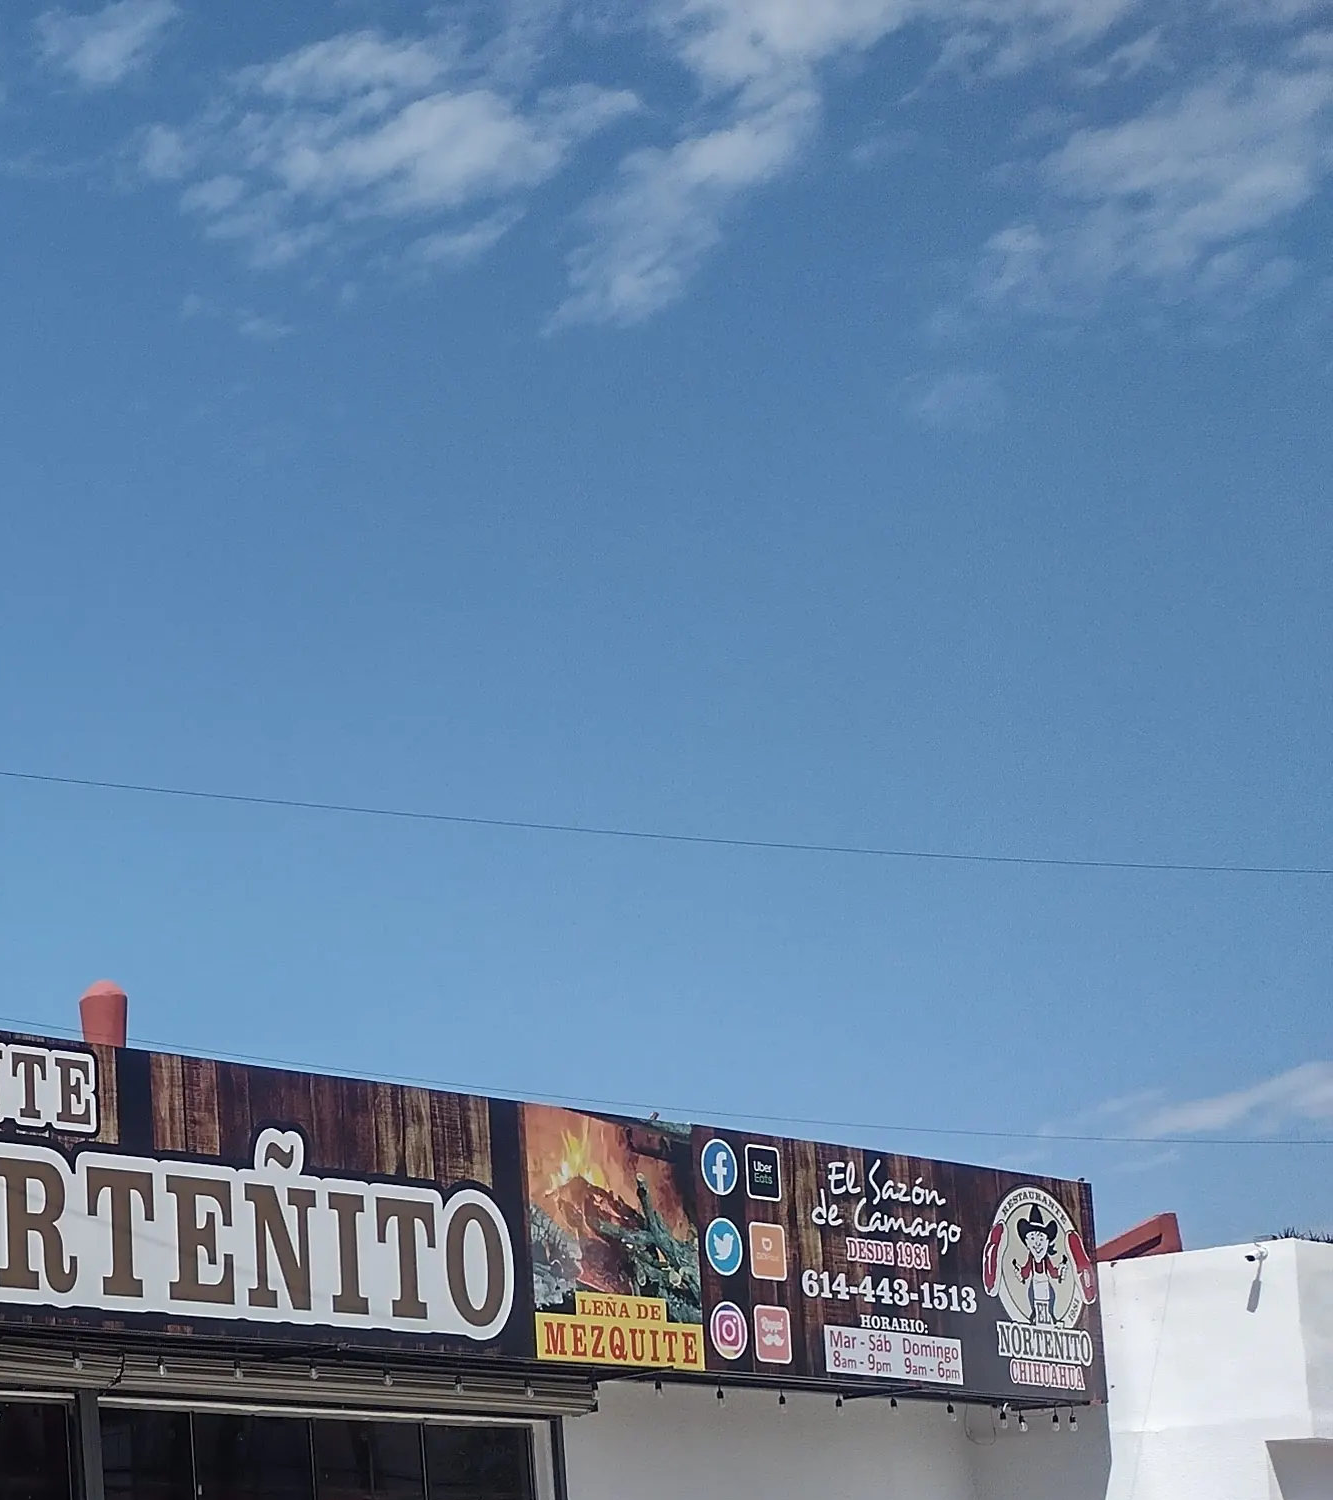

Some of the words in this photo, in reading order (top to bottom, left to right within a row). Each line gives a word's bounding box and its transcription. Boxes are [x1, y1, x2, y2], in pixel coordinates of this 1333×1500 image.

[753, 1160, 773, 1174] Uber
[754, 1172, 773, 1185] Eats
[828, 1161, 862, 1195] El
[868, 1159, 946, 1206] Sazón
[811, 1188, 843, 1226] de
[854, 1198, 962, 1255] Camargo
[846, 1238, 895, 1266] DESDE
[898, 1241, 931, 1270] 1981
[801, 1269, 978, 1314] 614-443-1513
[580, 1296, 631, 1319] LEÑA
[636, 1303, 662, 1321] DE
[1036, 1302, 1051, 1325] EL
[860, 1314, 929, 1334] HORARIO:
[543, 1321, 698, 1365] MEZQUITE
[830, 1330, 857, 1349] Mar
[869, 1333, 892, 1353] Sáb
[902, 1338, 959, 1363] Domingo
[833, 1351, 857, 1369] 8am
[868, 1355, 892, 1374] 9pm
[904, 1358, 927, 1376] 9am
[937, 1361, 960, 1381] 6pm
[1011, 1359, 1084, 1389] CHIHUAHUA
